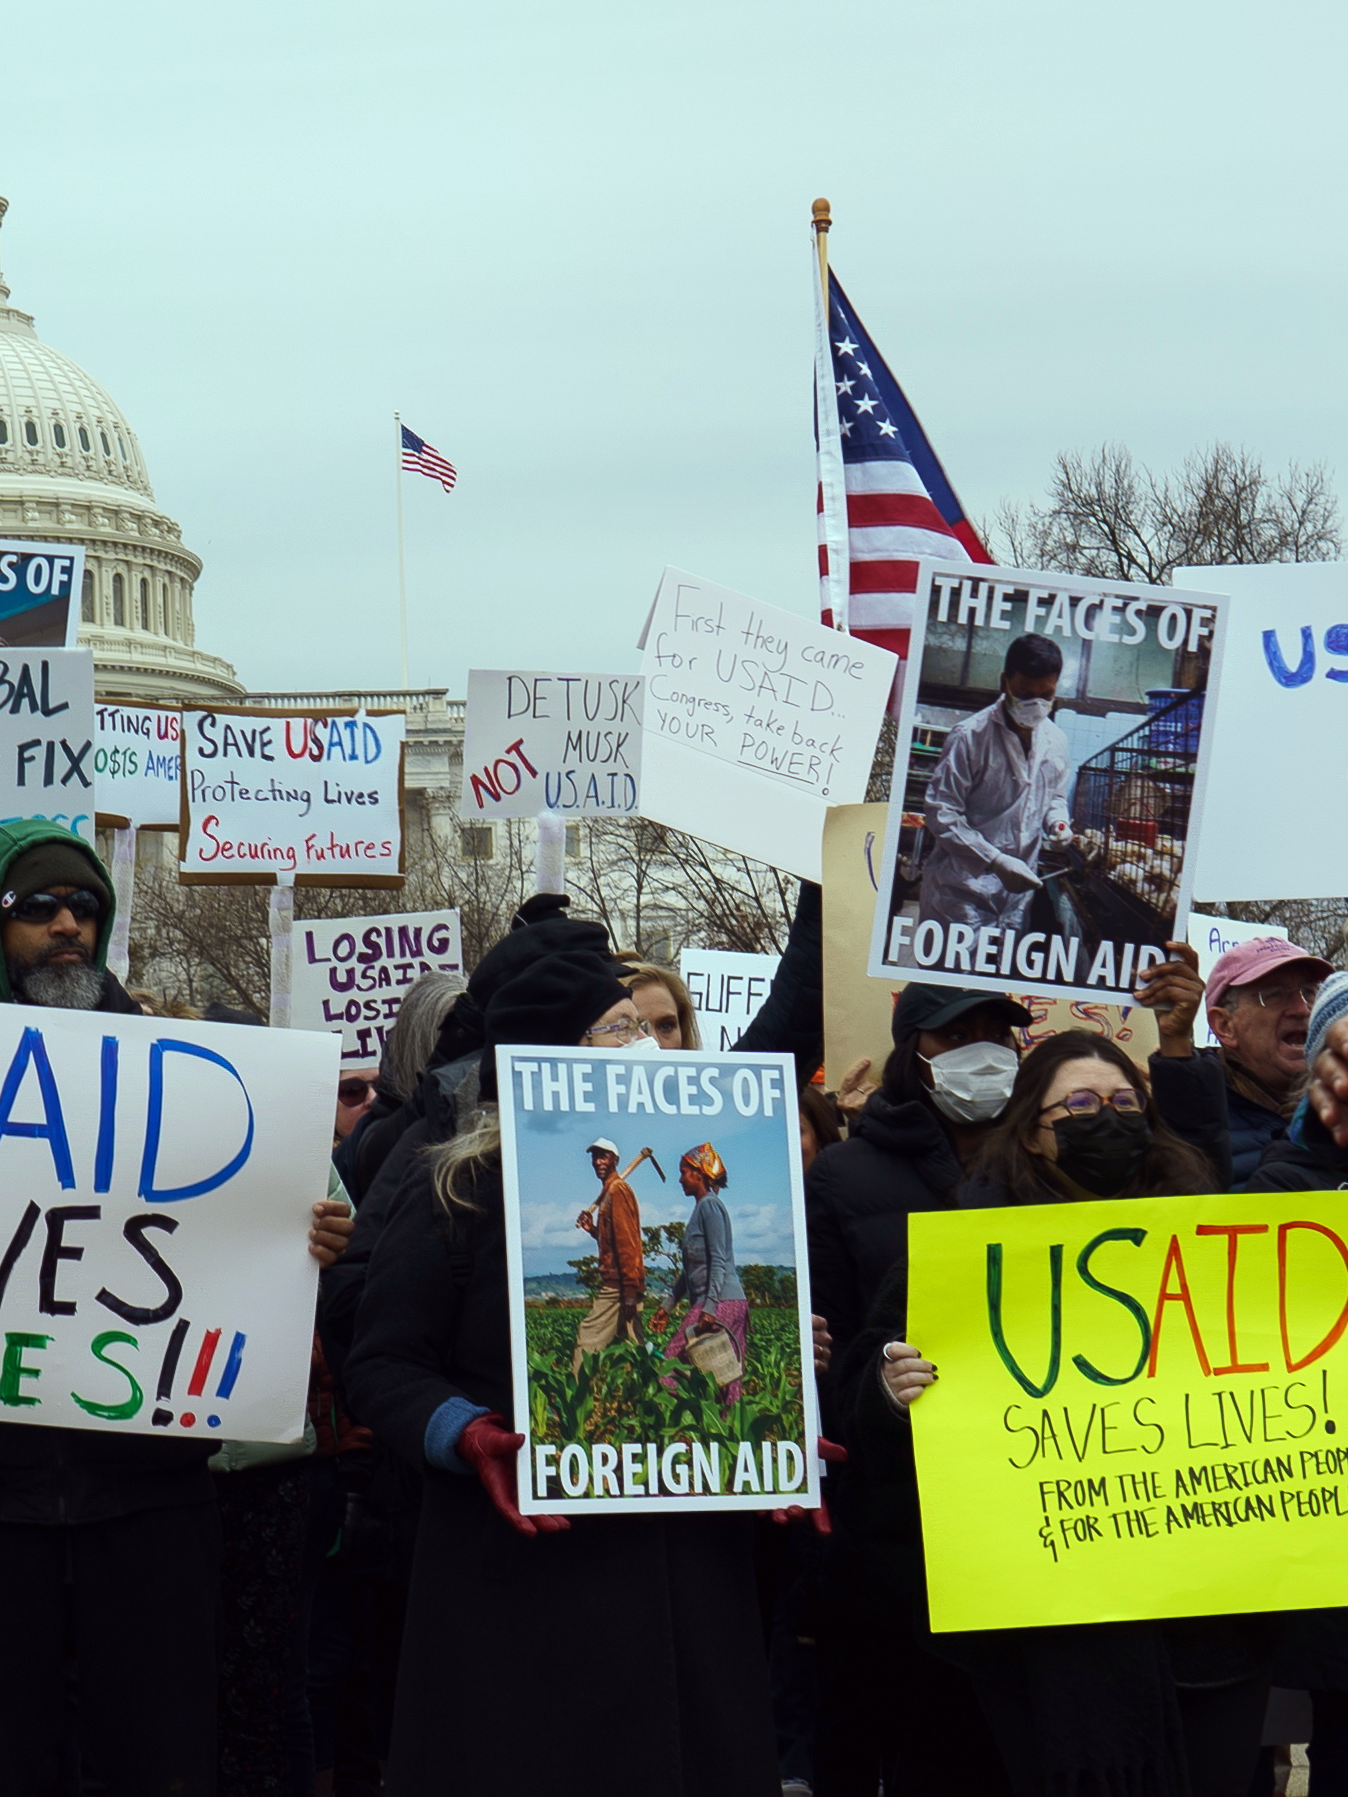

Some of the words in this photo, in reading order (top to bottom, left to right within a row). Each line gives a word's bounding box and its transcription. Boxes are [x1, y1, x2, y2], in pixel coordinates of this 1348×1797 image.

[26, 556, 71, 595] OF
[674, 584, 726, 637] First
[741, 611, 788, 673] they
[801, 645, 865, 680] came
[934, 576, 1011, 631] THE
[1024, 588, 1147, 645] FACES
[1157, 603, 1213, 653] OF
[654, 632, 698, 670] for
[96, 707, 152, 740] TTING
[157, 714, 180, 742] US
[507, 676, 641, 726] DETUSK
[649, 674, 734, 724] Congress,
[744, 707, 786, 738] take
[791, 721, 844, 764] back
[17, 738, 93, 789] FIX
[94, 745, 138, 779] O$TS
[144, 749, 181, 781] AMER
[197, 713, 276, 762] SAVE
[285, 717, 383, 765] USAID
[563, 730, 629, 768] MUSK
[657, 709, 717, 747] YOUR
[740, 732, 835, 797] POWER!
[190, 769, 312, 816] Protecting
[323, 780, 380, 805] Lives
[469, 739, 538, 809] NOT
[545, 770, 638, 812] U.S.A.I.D.
[199, 815, 296, 871] Securing
[304, 831, 392, 865] Futures
[305, 923, 450, 965] LOSING
[887, 916, 1078, 984] FOREIGN
[1087, 939, 1166, 990] AID
[322, 997, 402, 1024] LOSI
[687, 972, 773, 1015] SUFF
[514, 1062, 595, 1112] THE
[605, 1064, 724, 1116] FACES
[732, 1068, 782, 1117] OF
[986, 1220, 1348, 1399] USAID
[1003, 1397, 1165, 1469] SAVES
[1185, 1369, 1337, 1450] LIVES!
[536, 1442, 721, 1497] FOREIGN
[733, 1440, 805, 1493] AID
[1039, 1477, 1107, 1513] FROM
[1119, 1472, 1166, 1503] THE
[1175, 1455, 1294, 1493] AMERICAN
[1299, 1447, 1348, 1480] PEOP
[1060, 1517, 1103, 1549] FOR
[1109, 1510, 1159, 1539] THE
[1165, 1494, 1277, 1535] AMERICAN
[1279, 1486, 1348, 1522] PEOPL
